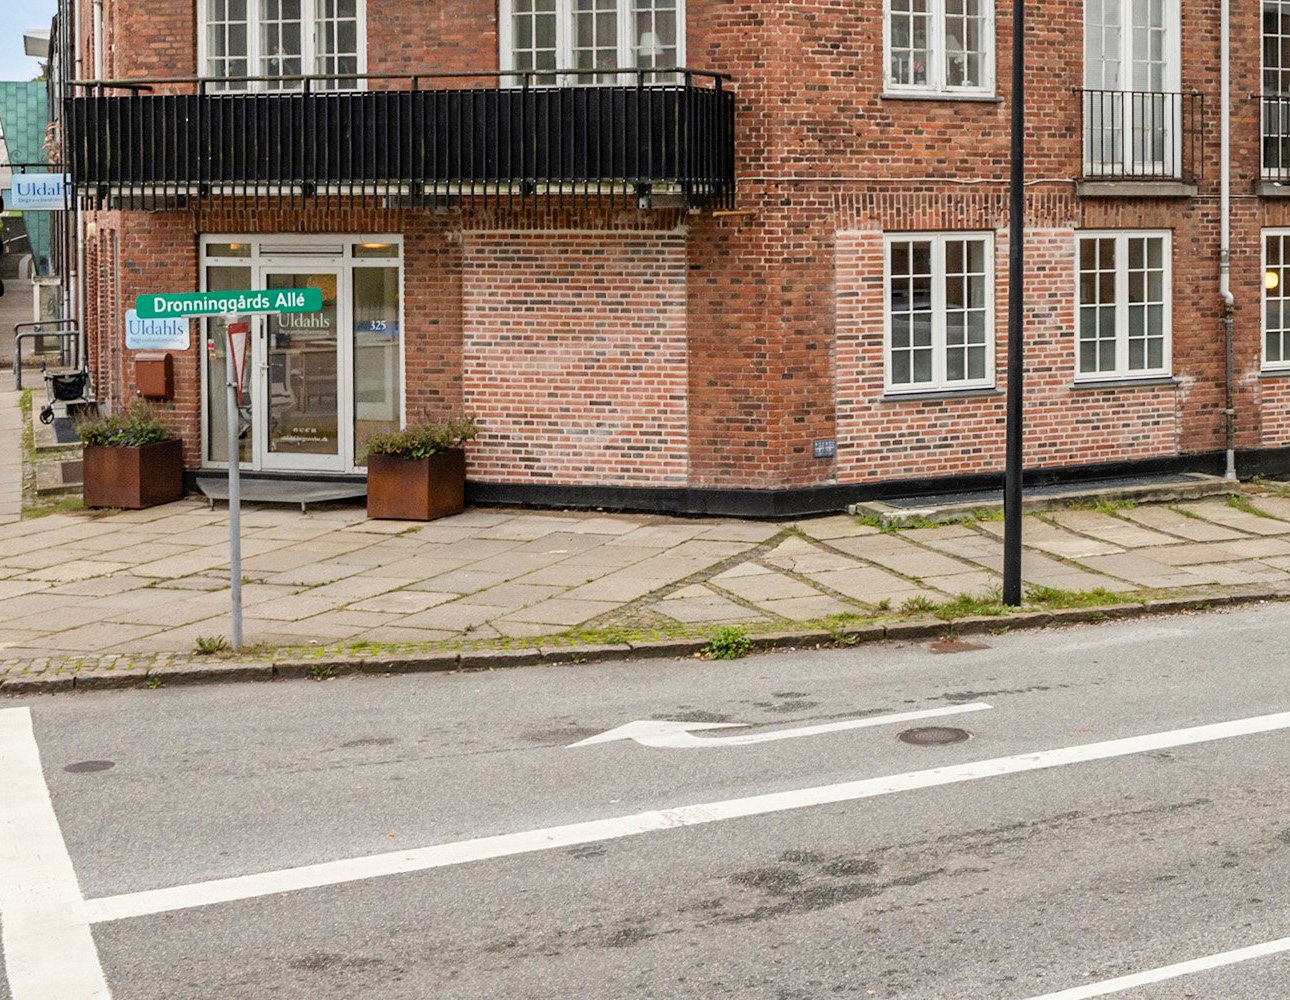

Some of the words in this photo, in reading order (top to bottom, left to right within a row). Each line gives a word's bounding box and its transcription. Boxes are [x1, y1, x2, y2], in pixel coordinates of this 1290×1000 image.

[153, 293, 270, 314] Dronninggårds
[275, 292, 305, 307] Allé
[129, 320, 184, 335] Uldahls
[277, 312, 330, 328] Uldahls
[369, 320, 387, 331] 325
